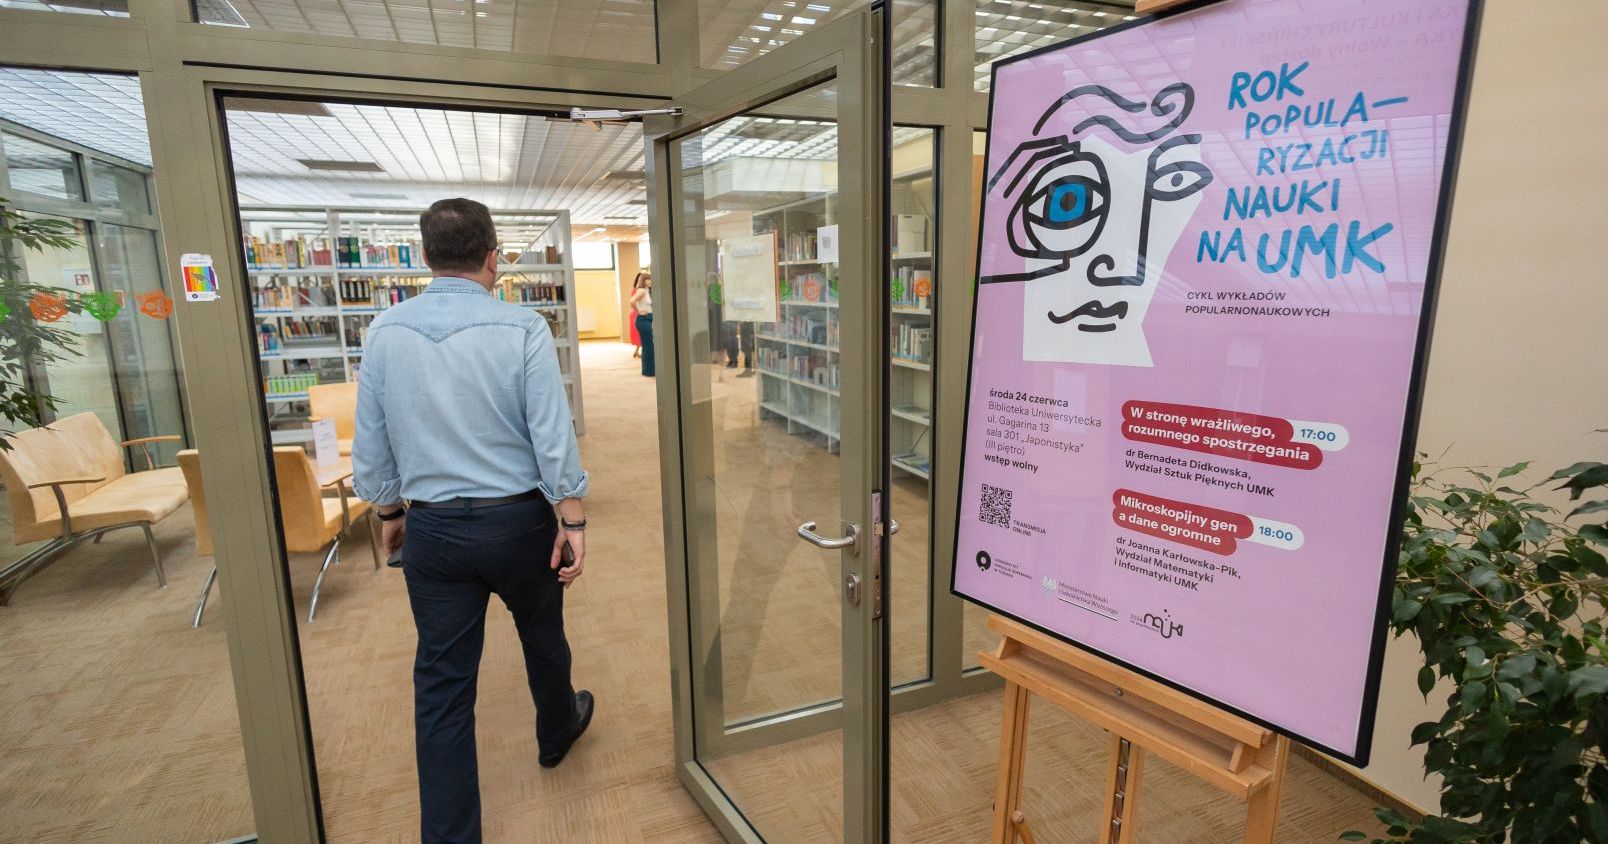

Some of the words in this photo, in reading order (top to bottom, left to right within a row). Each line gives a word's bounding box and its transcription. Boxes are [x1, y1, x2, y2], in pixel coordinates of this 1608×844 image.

[1228, 61, 1309, 110] ROK
[1256, 129, 1387, 176] RYZACJI
[1223, 178, 1340, 221] NAUKI
[1197, 227, 1246, 263] NA
[1257, 220, 1394, 279] UMK
[1185, 305, 1330, 317] POPULARNONAUKOWYCH
[1187, 291, 1213, 301] CYKL
[1217, 290, 1286, 301] WYKŁADÓW
[989, 388, 1014, 400] środa
[1015, 391, 1027, 402] 24
[1029, 395, 1069, 408] czerwca
[987, 415, 997, 424] ul.
[998, 416, 1037, 431] Gagarina
[1039, 423, 1050, 433] 13
[988, 401, 1030, 416] Biblioteka
[1031, 408, 1102, 428] Uniwersytecka
[1130, 406, 1144, 419] W
[1145, 410, 1187, 427] stronę
[1190, 417, 1276, 440] wrażliwego,
[985, 439, 996, 450] (III
[997, 443, 1026, 457] piętro)
[986, 428, 1002, 438] sala
[1004, 430, 1019, 441] 301
[1128, 424, 1200, 445] rozumnego
[1202, 435, 1310, 461] spostrzegania
[1300, 428, 1336, 442] 17:00
[984, 454, 1010, 467] wstęp
[1012, 460, 1039, 474] wolny
[1125, 448, 1136, 457] dr
[1137, 450, 1187, 467] Bernadeta
[1189, 460, 1252, 480] Didkowska,
[1125, 459, 1162, 475] Wydział
[1164, 467, 1192, 481] Sztuk
[1194, 473, 1244, 490] Pięknych
[1246, 483, 1275, 497] UMK
[1012, 519, 1047, 534] TRANSMISJA
[1118, 512, 1126, 521] a
[1128, 513, 1159, 529] dane
[1161, 523, 1221, 546] ogromne
[1120, 495, 1208, 528] Mikroskopijny
[1210, 518, 1237, 533] gen
[1259, 526, 1293, 541] 18:00
[1116, 536, 1126, 545] dr
[1128, 539, 1160, 555] Joanna
[1162, 548, 1241, 579] Karłowska-Pik,
[1116, 546, 1152, 564] Wydział
[1153, 558, 1214, 583] Matematyki
[1118, 559, 1172, 582] Informatyki
[1174, 576, 1199, 591] UMK
